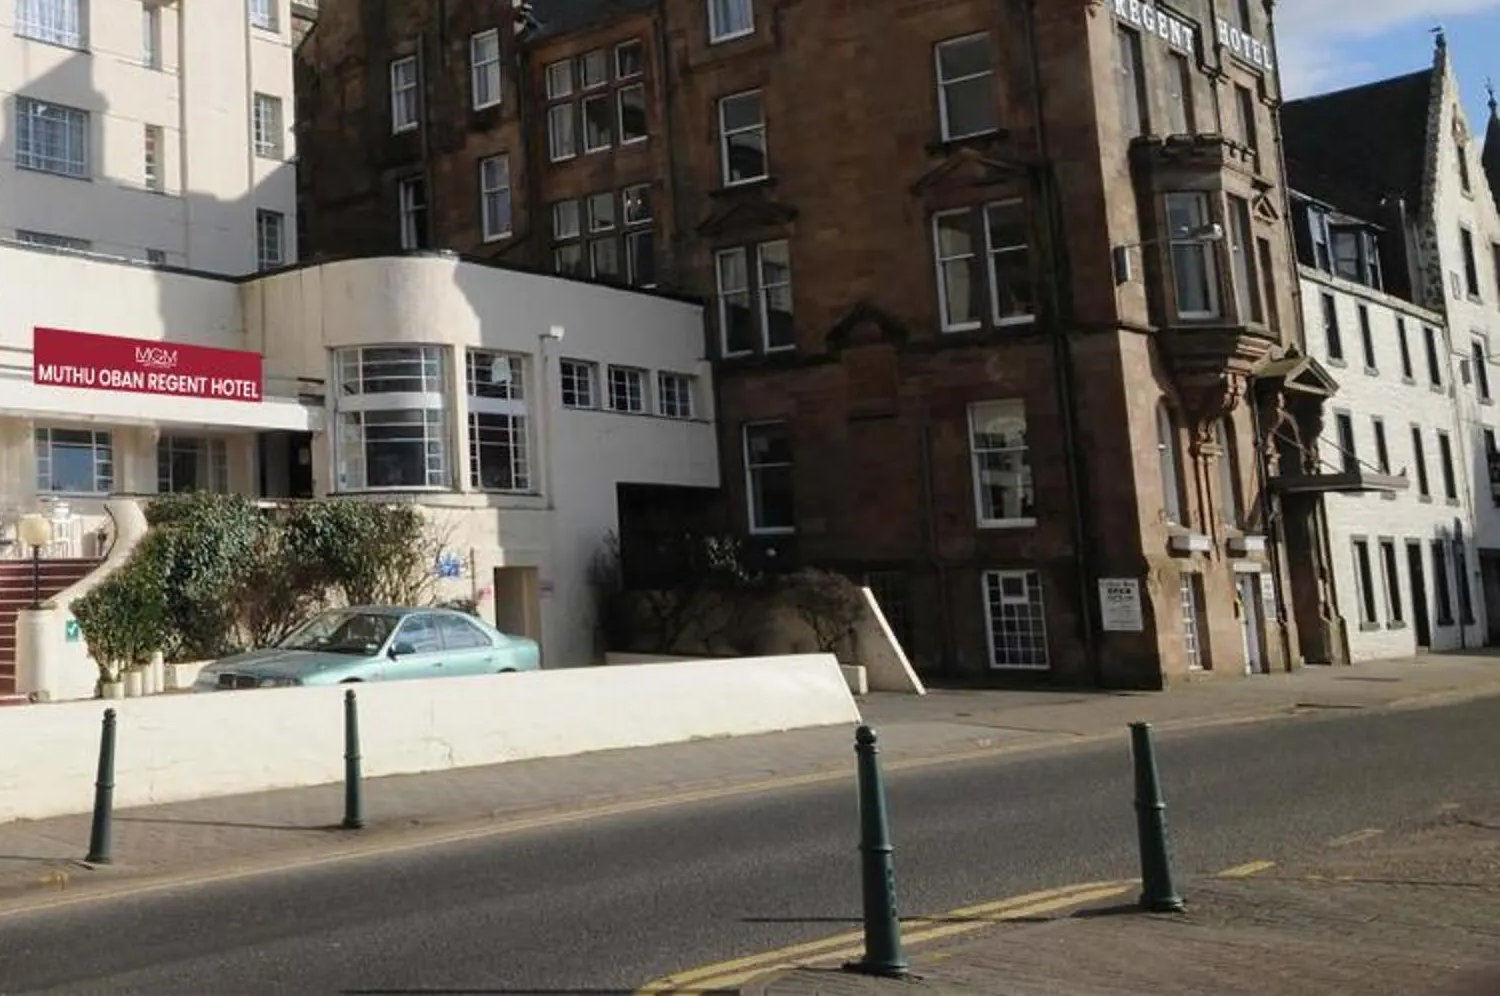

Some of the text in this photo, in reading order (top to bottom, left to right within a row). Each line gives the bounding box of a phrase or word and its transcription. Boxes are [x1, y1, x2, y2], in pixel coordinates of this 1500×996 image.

[1217, 17, 1273, 70] HOTEL
[135, 347, 178, 363] MGM
[38, 364, 259, 398] MUTHU OBAN REGENT HOTEL
